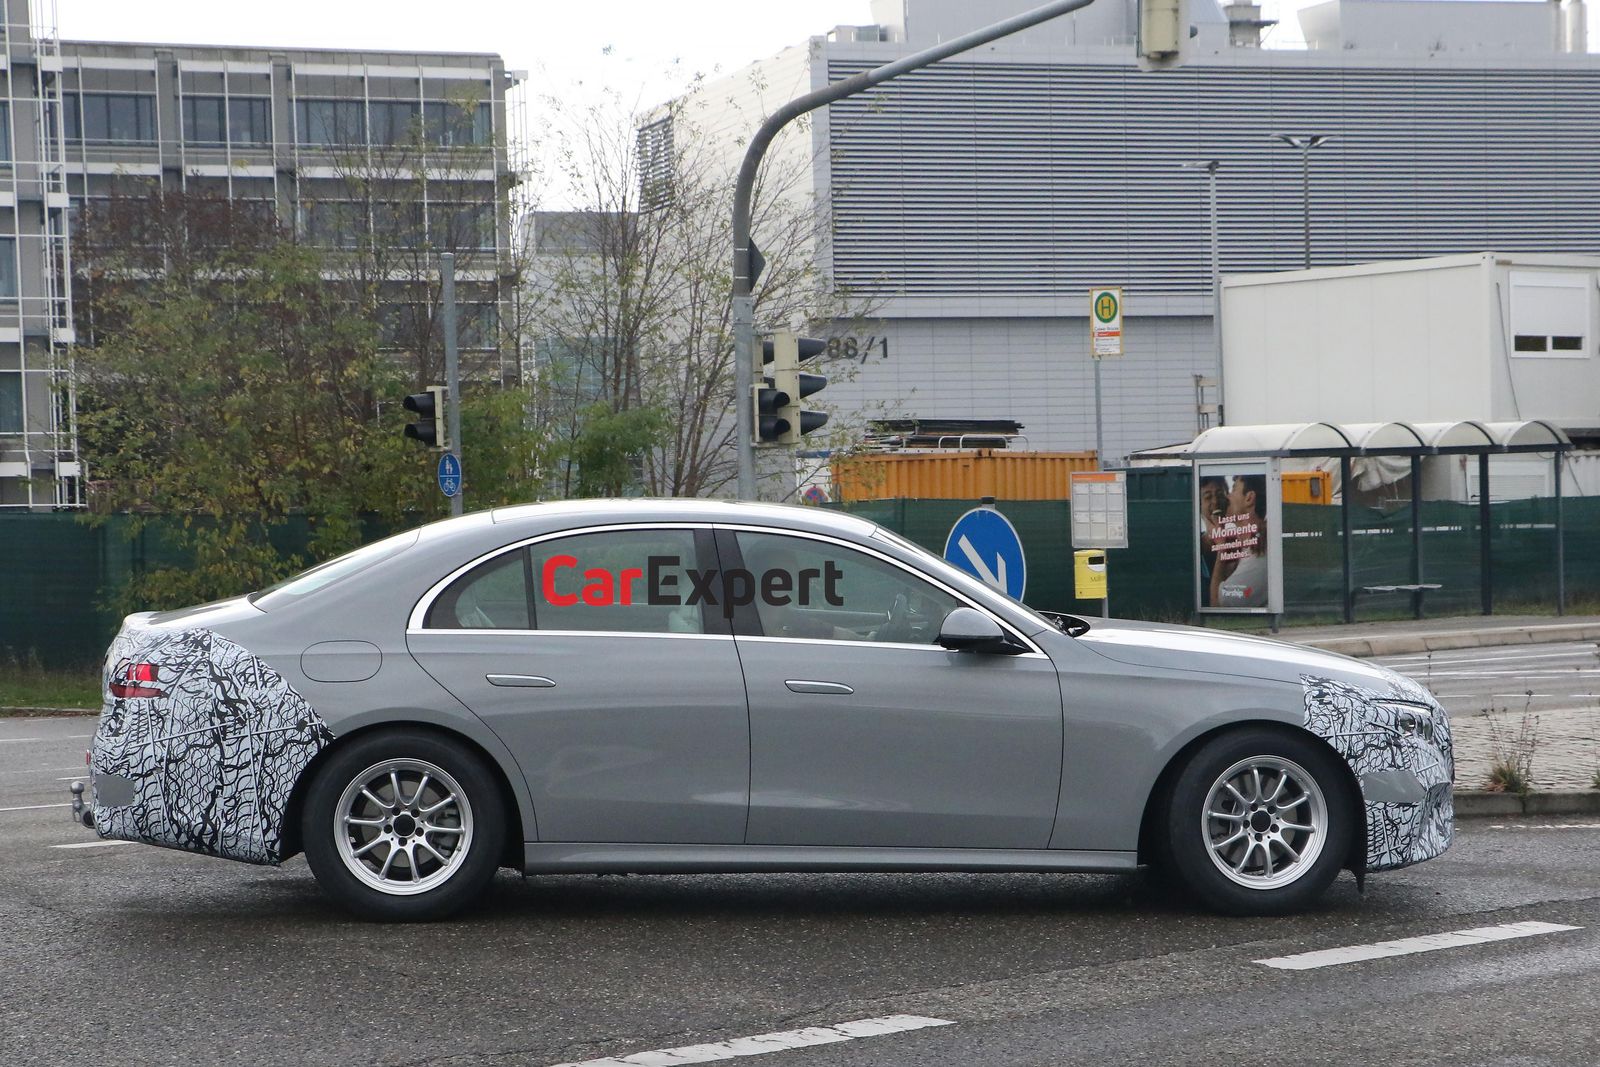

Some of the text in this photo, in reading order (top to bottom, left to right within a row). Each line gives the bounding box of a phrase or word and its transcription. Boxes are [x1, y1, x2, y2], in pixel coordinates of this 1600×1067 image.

[1101, 299, 1111, 316] H
[1218, 512, 1250, 524] Lasst uns
[1211, 523, 1258, 539] Momente
[1211, 537, 1258, 552] sammeln statt
